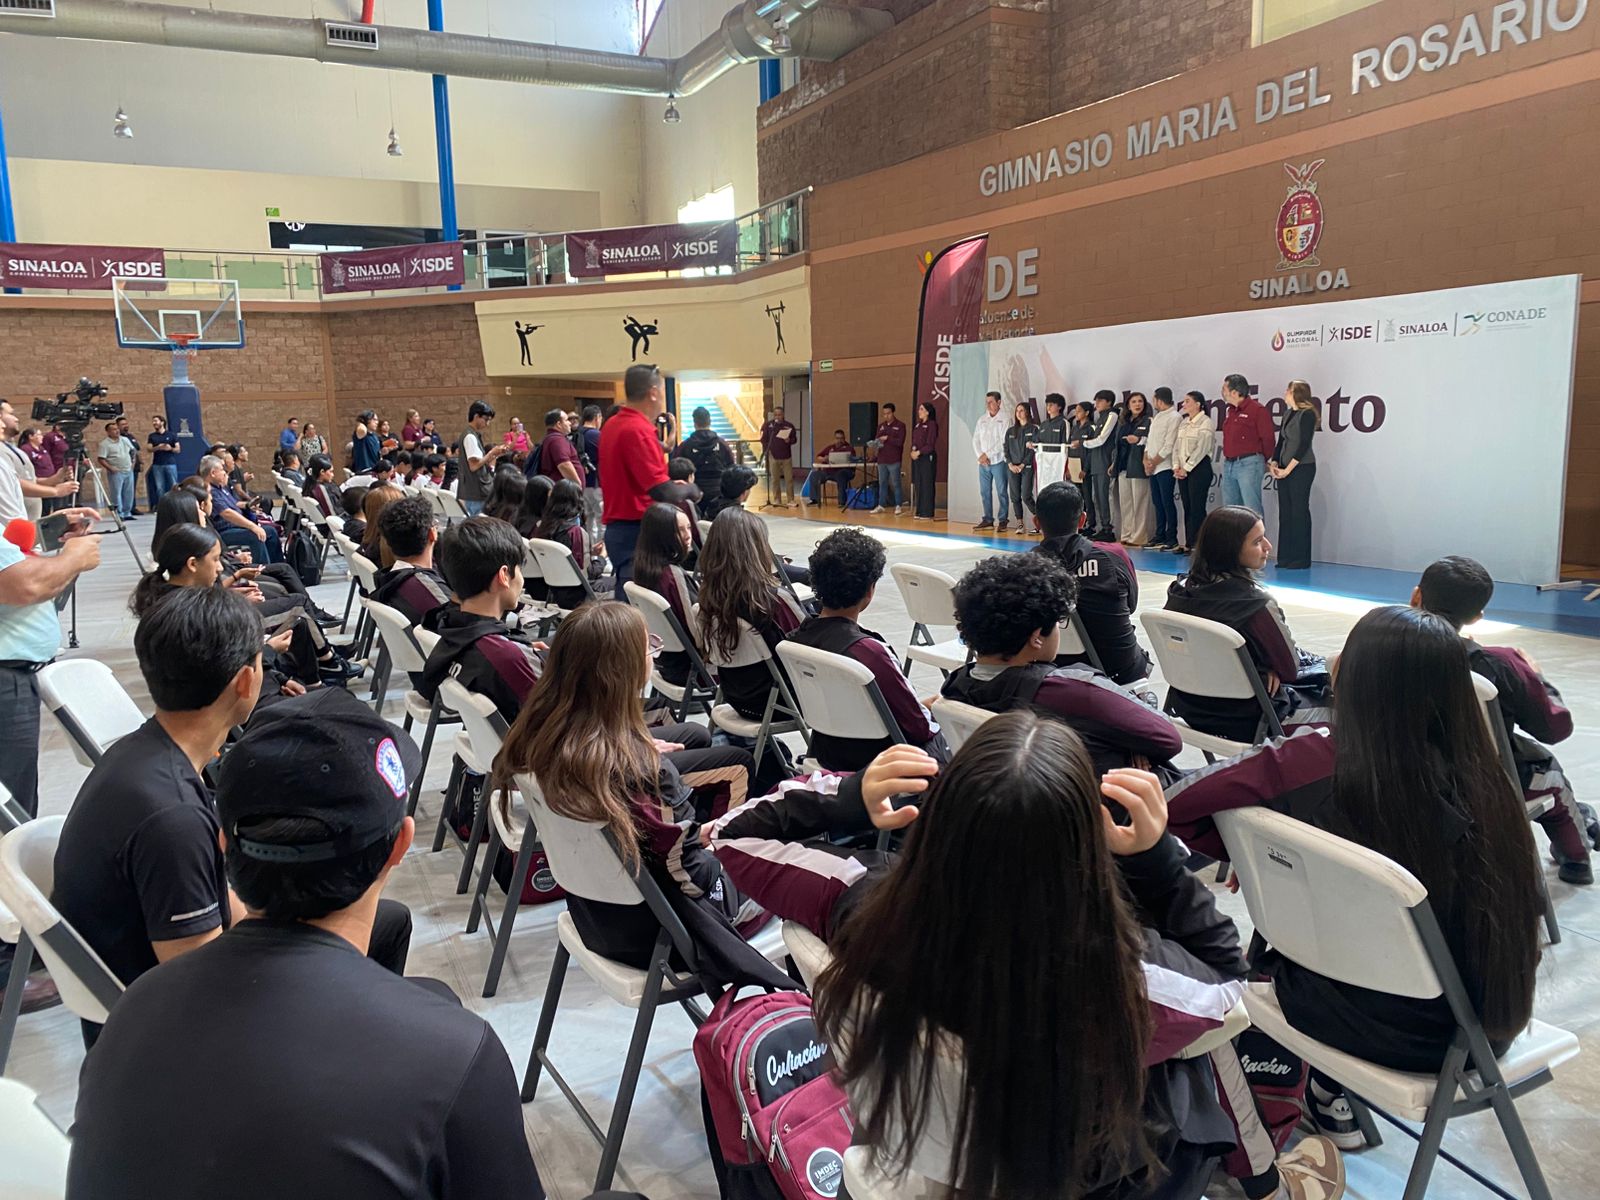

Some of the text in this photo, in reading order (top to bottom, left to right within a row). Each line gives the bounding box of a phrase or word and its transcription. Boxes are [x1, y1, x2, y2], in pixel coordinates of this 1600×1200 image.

[979, 0, 1589, 197] GIMNASIO MARIA DEL ROSARIO
[602, 240, 718, 260] SINALOA ISDE
[8, 259, 162, 277] SINALOA ISDE
[347, 256, 454, 278] SINALOA ISDE
[1249, 267, 1350, 299] SINALOA
[1487, 307, 1547, 323] CONADE
[1286, 322, 1448, 341] OLIMPIADA ISDE SINALOA
[1286, 336, 1319, 344] NACIONAL
[934, 334, 953, 383] ISDE
[766, 1040, 828, 1087] Culiacán
[814, 1160, 838, 1179] IMDEC
